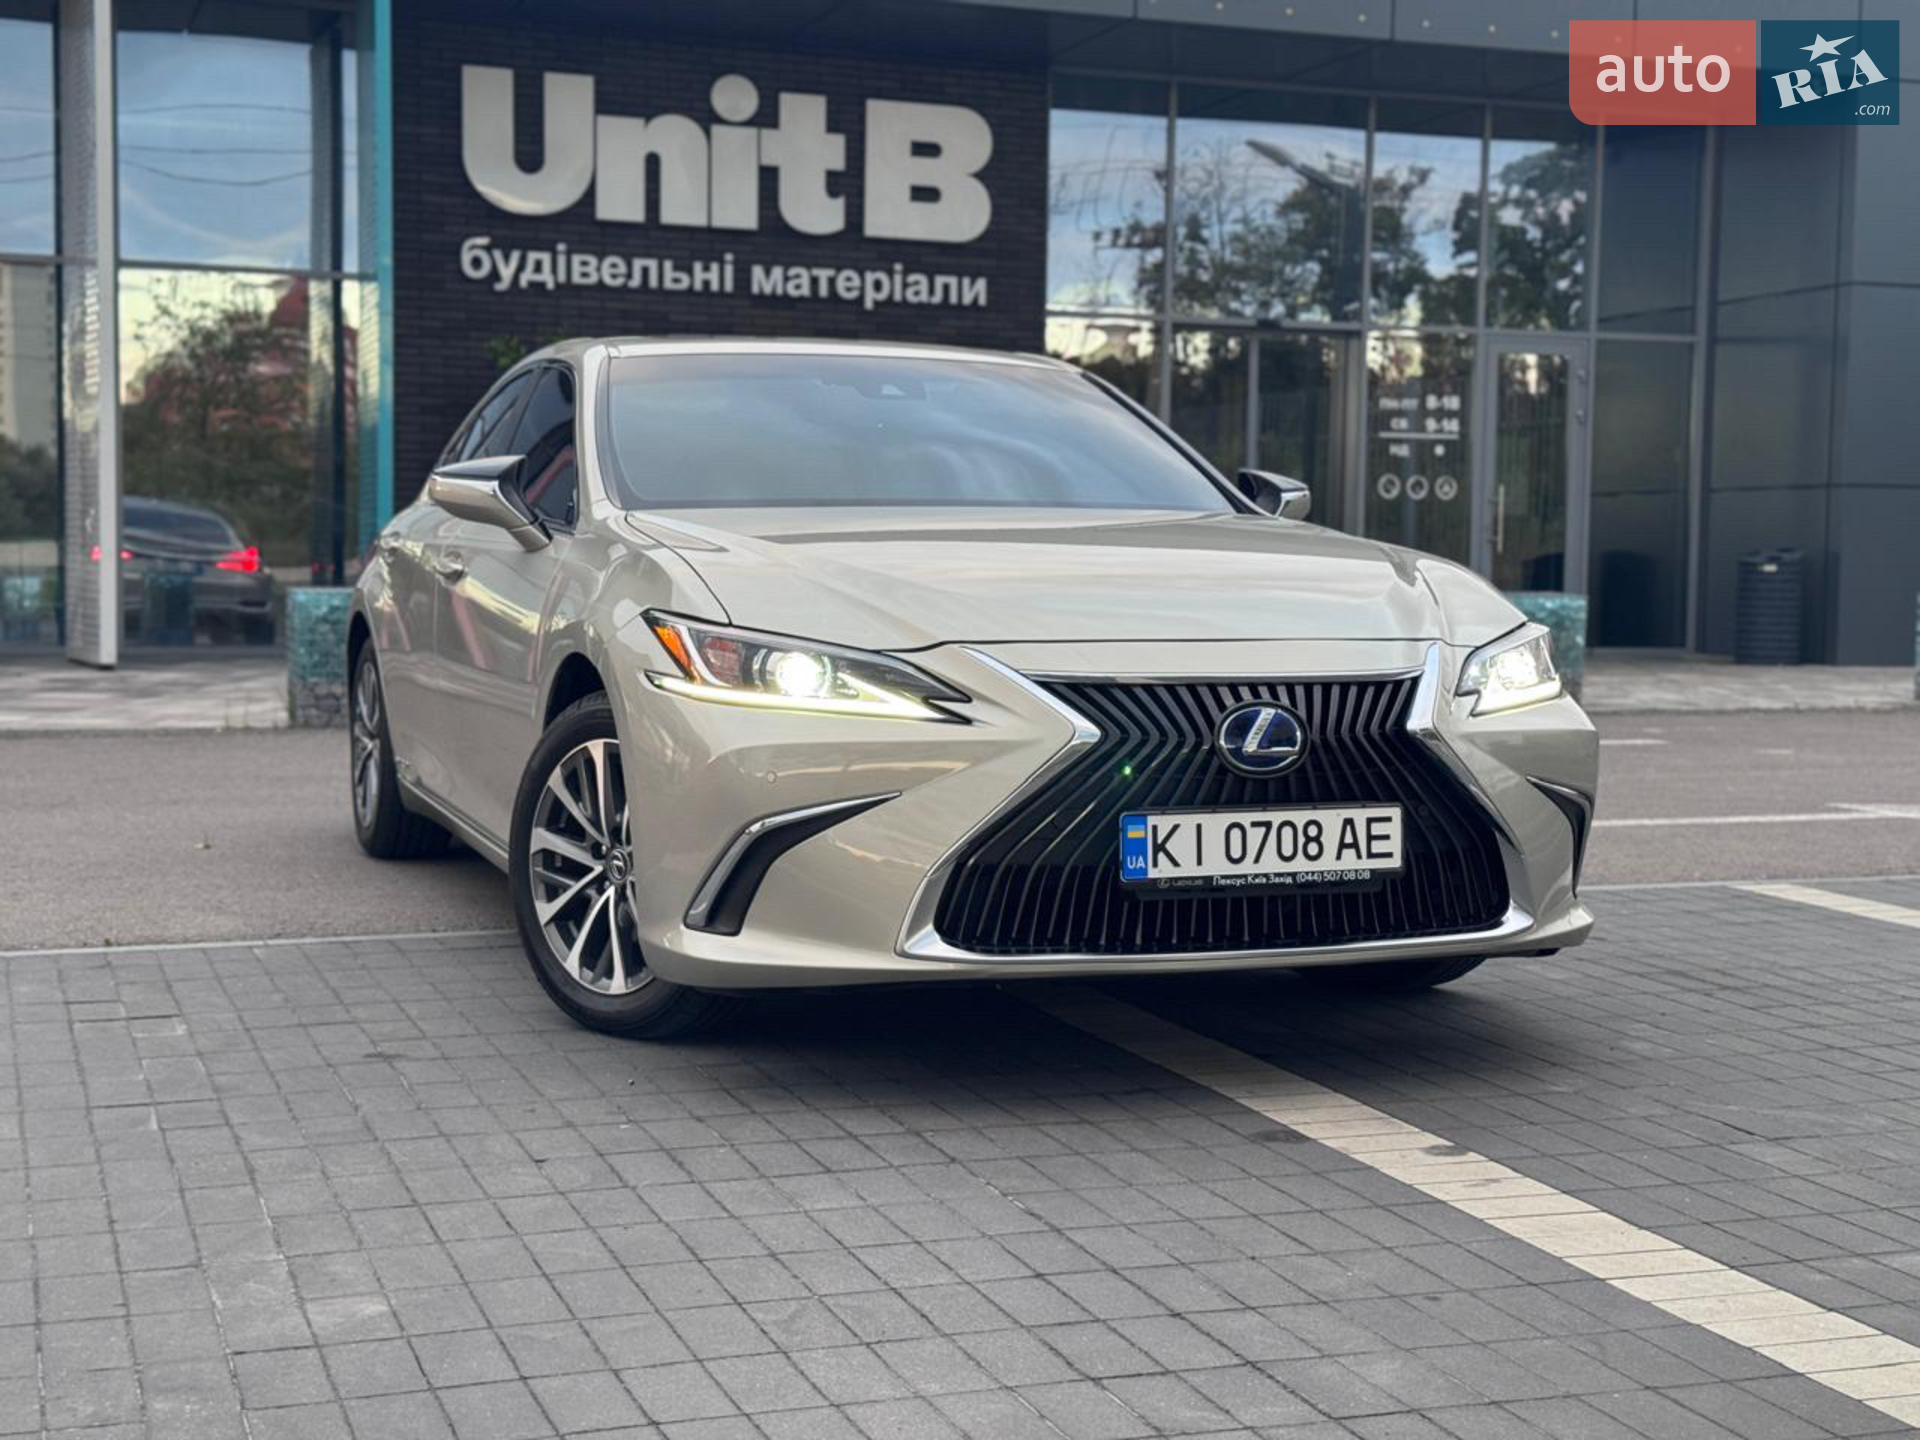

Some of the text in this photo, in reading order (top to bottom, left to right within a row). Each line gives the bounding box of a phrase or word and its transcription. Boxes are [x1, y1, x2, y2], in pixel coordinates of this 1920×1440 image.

[459, 236, 988, 310] будівельні матеріали
[1152, 816, 1394, 869] KI 0708 AE
[1127, 855, 1146, 870] UA
[1296, 871, 1322, 884] (044)
